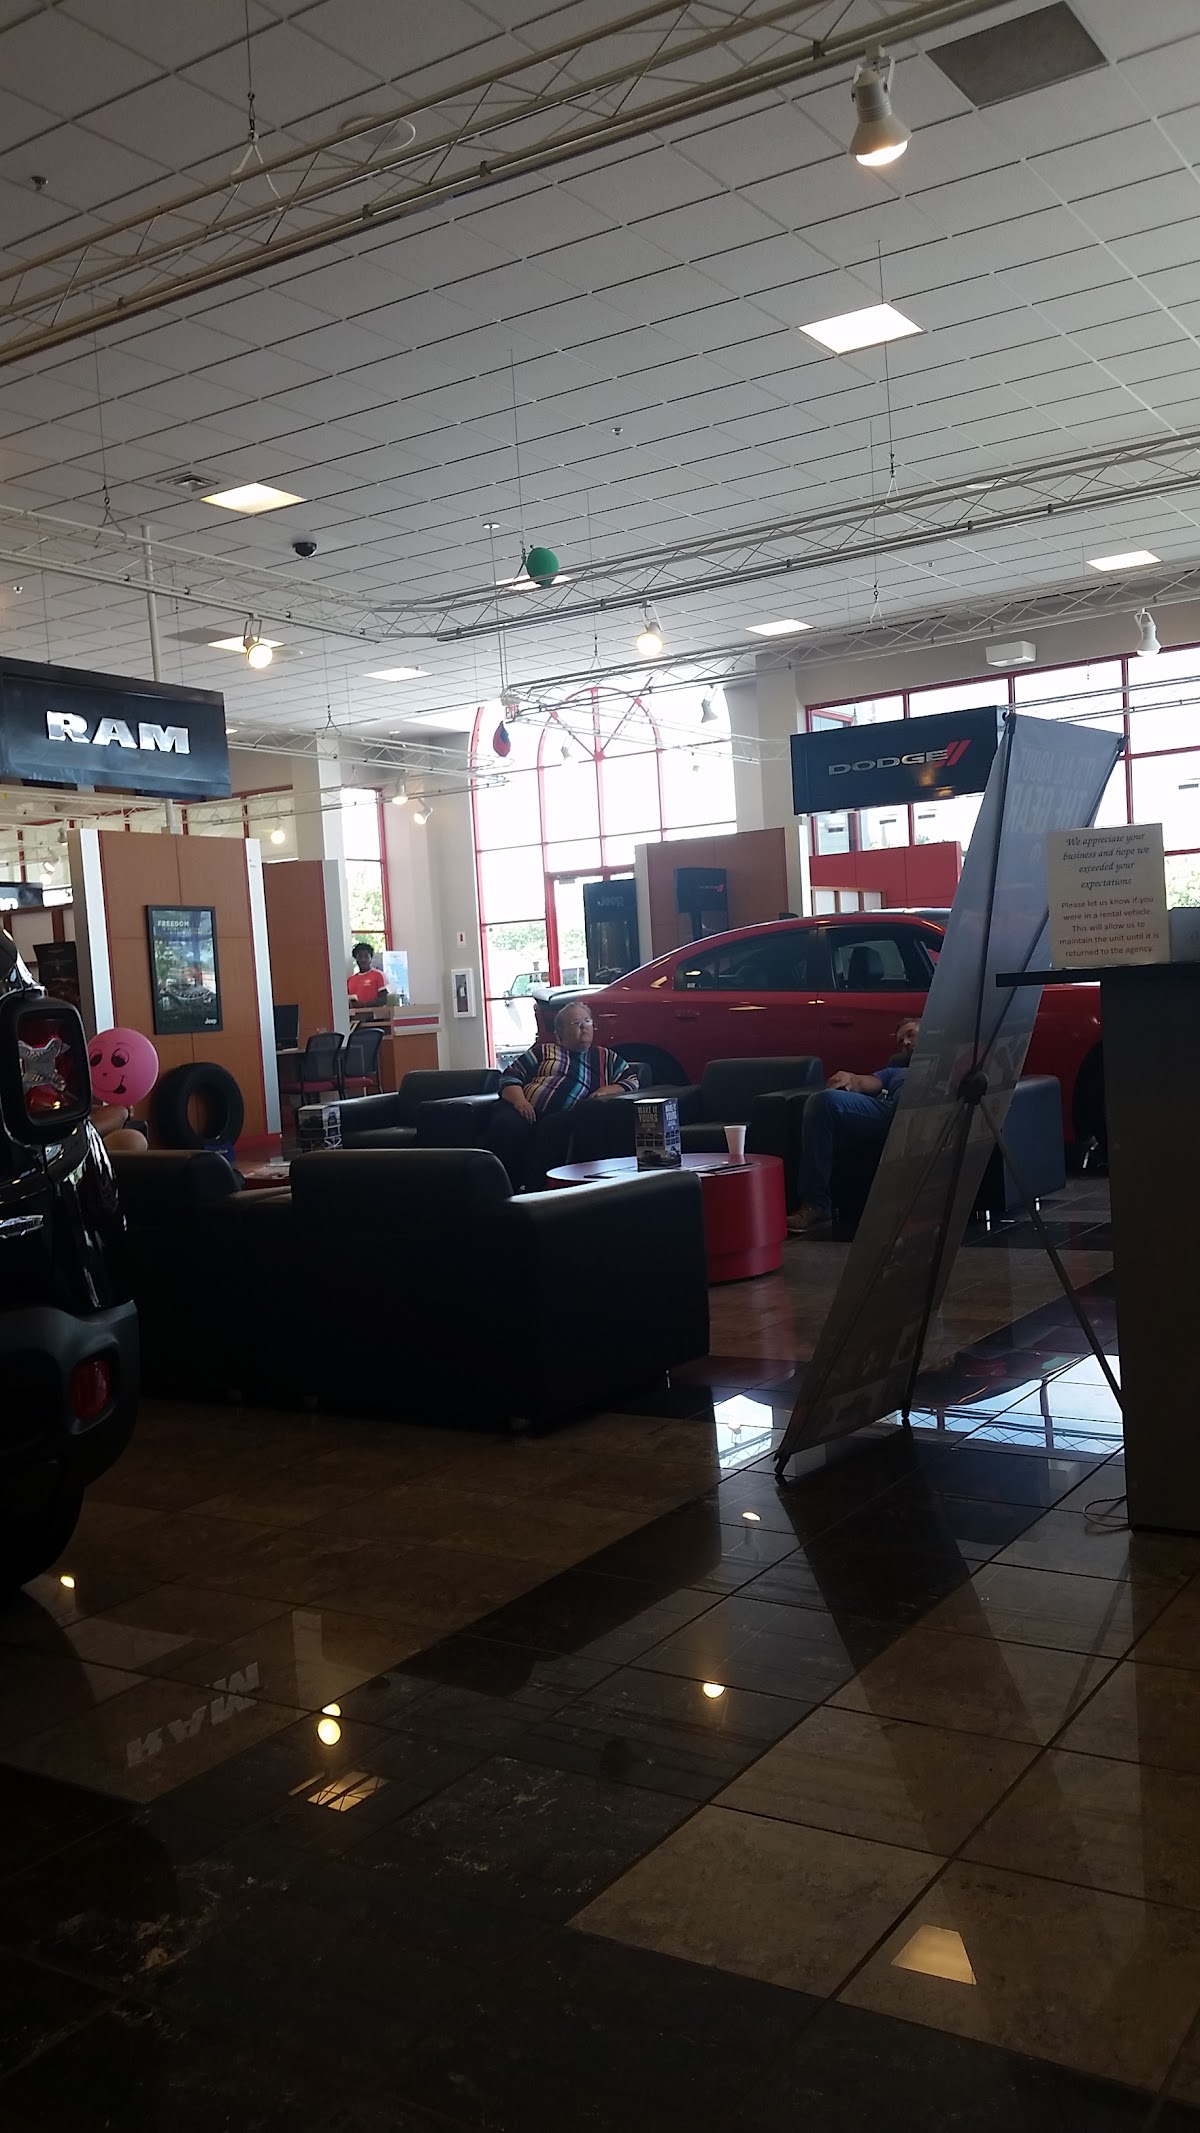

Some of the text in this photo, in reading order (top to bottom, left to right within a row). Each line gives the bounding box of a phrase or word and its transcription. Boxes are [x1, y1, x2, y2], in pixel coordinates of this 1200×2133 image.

[46, 710, 191, 754] RAM
[828, 749, 949, 775] DODGE
[1066, 833, 1145, 848] We appreciate your
[1062, 851, 1097, 861] business
[1098, 847, 1115, 857] and
[1115, 846, 1135, 858] hope
[1078, 861, 1135, 873] exceeded your
[1080, 878, 1132, 891] expectations
[1061, 901, 1086, 909] Please
[1087, 899, 1097, 907] let
[1132, 896, 1139, 904] if
[1139, 896, 1154, 905] you
[1099, 910, 1122, 918] rental
[1123, 908, 1151, 917] vehicle
[1089, 923, 1103, 931] will
[1104, 922, 1124, 930] allow
[1059, 937, 1093, 946] maintain
[1094, 935, 1108, 943] the
[1126, 933, 1144, 941] until
[1065, 949, 1099, 957] returned
[1110, 947, 1124, 955] the
[1125, 945, 1153, 955] agency
[637, 1106, 652, 1114] MAKE
[638, 1113, 658, 1123] YOURS
